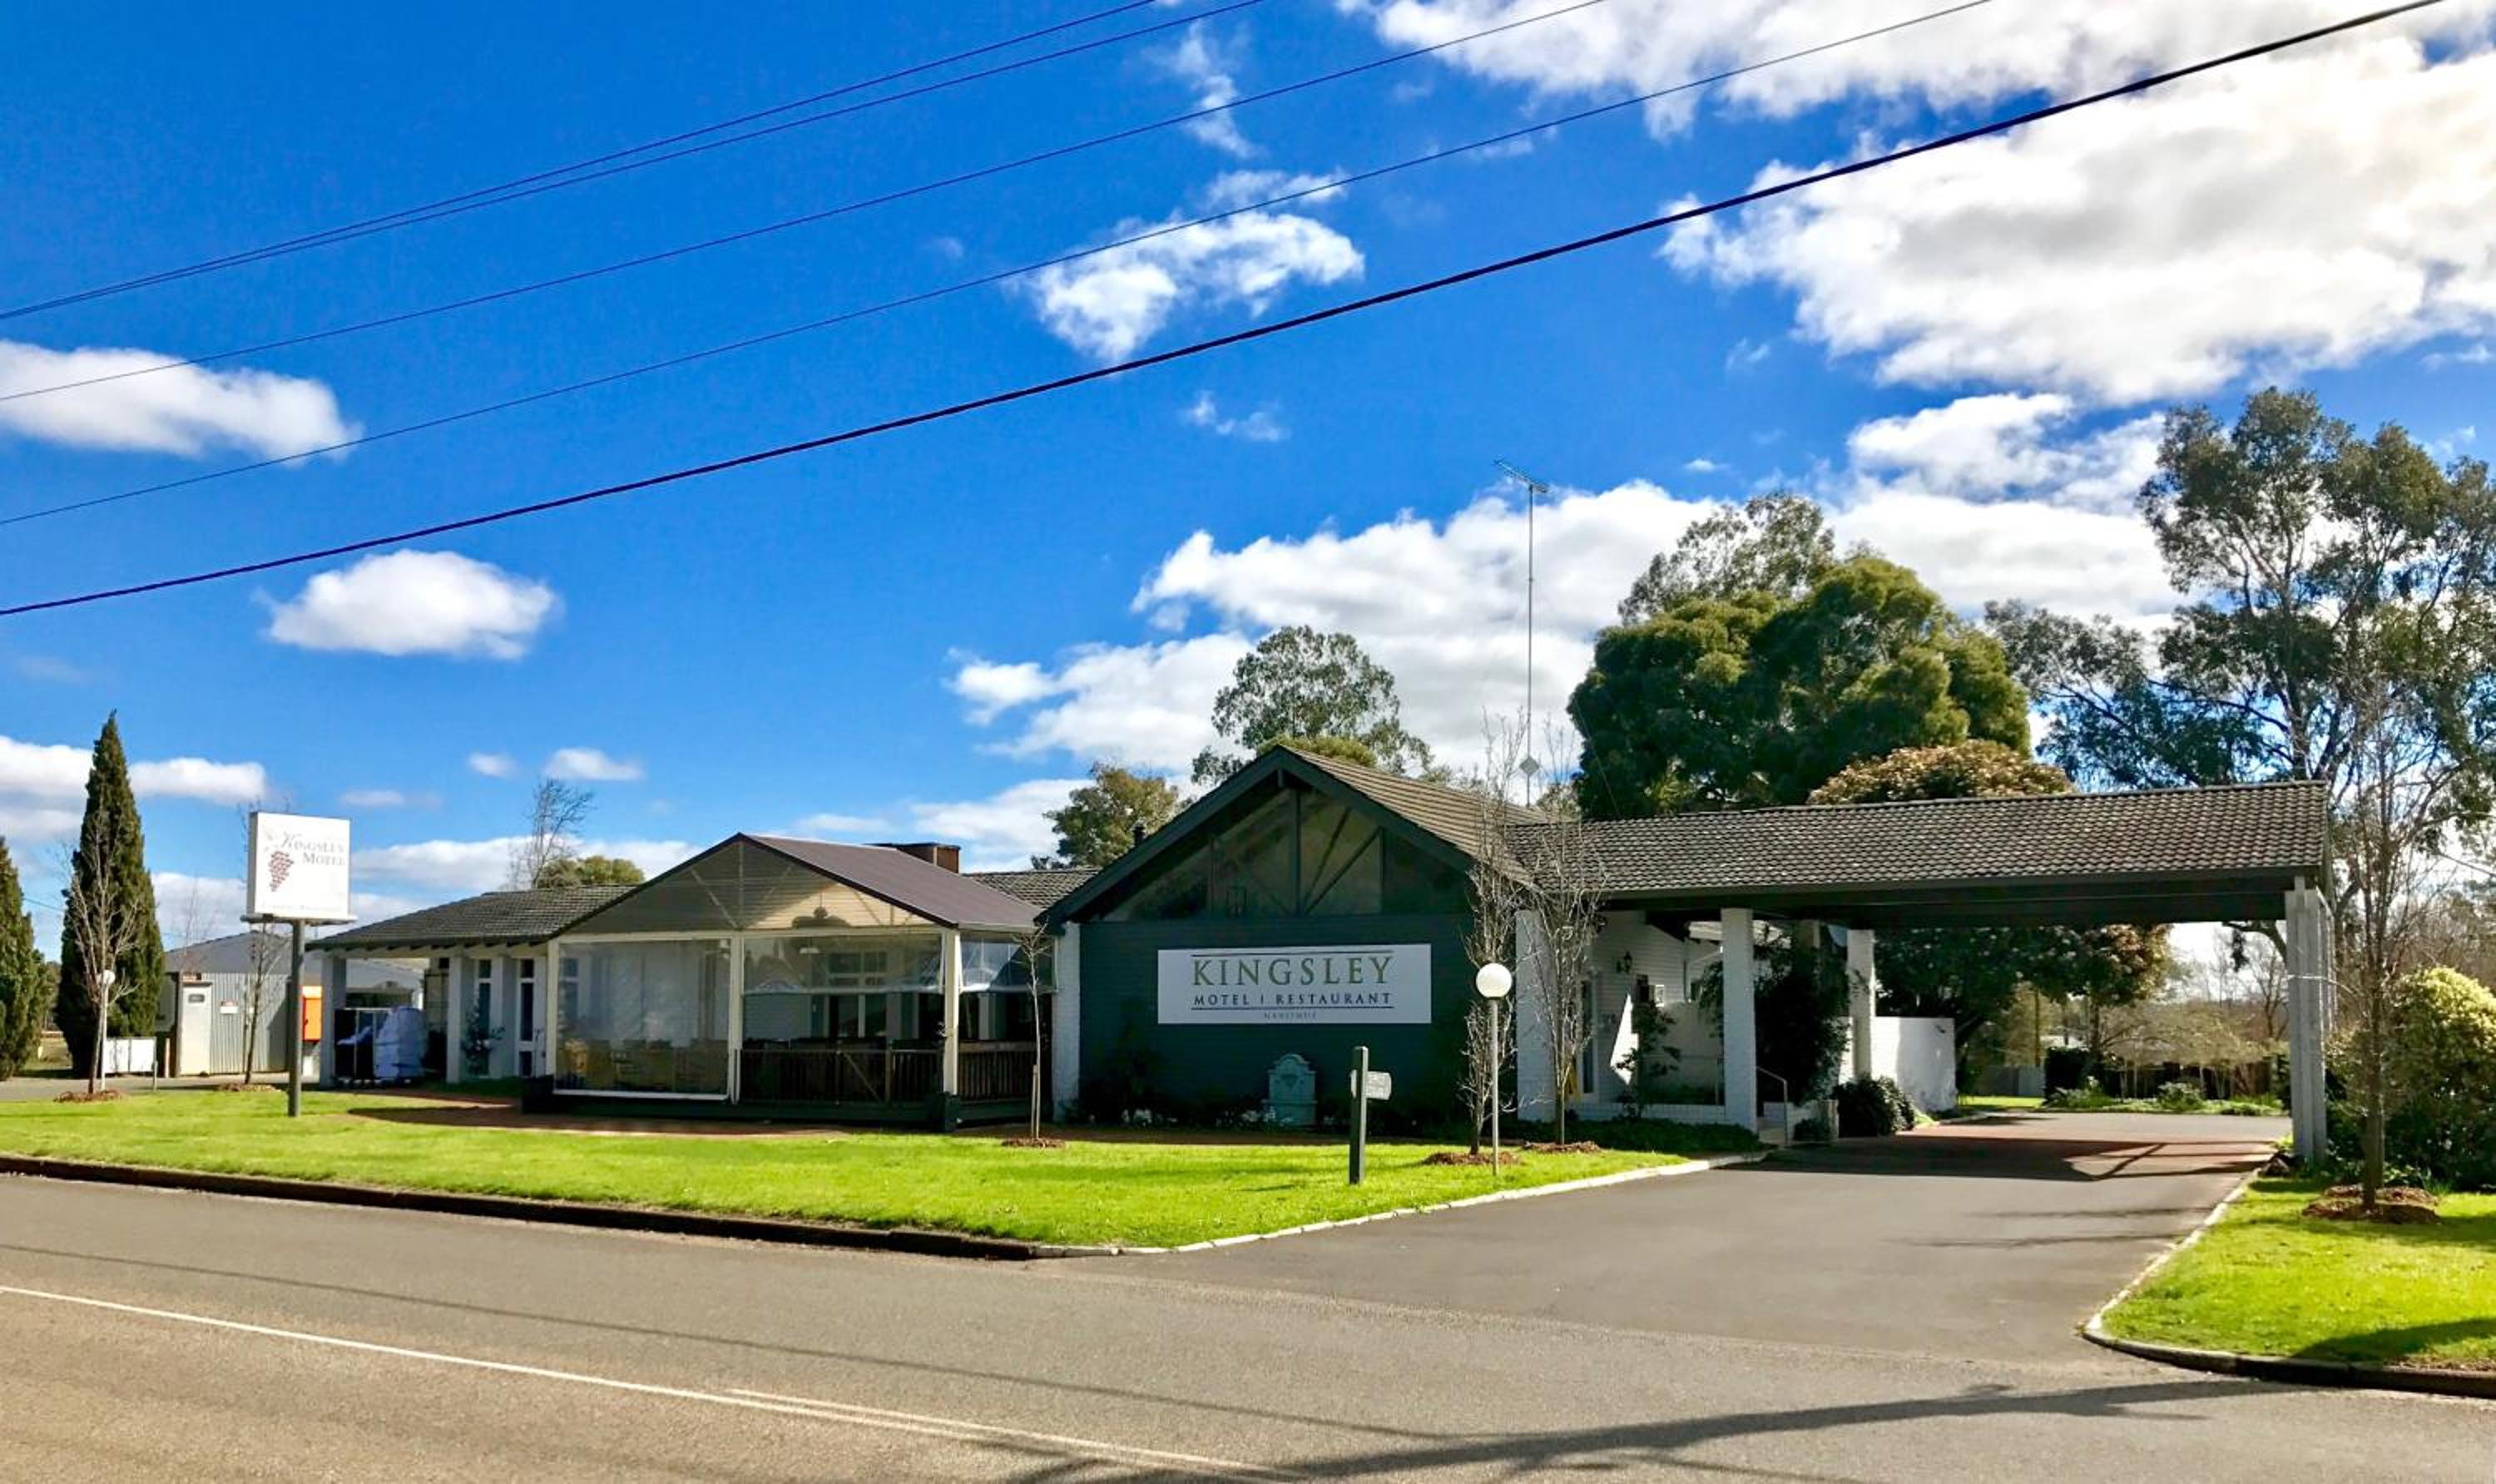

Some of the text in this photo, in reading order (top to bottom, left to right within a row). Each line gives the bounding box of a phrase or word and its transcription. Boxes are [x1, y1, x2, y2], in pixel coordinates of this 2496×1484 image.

[1191, 957, 1393, 986] KINGSLEY
[1194, 994, 1250, 1006] MOTEL
[1275, 992, 1391, 1005] RESTAURANT
